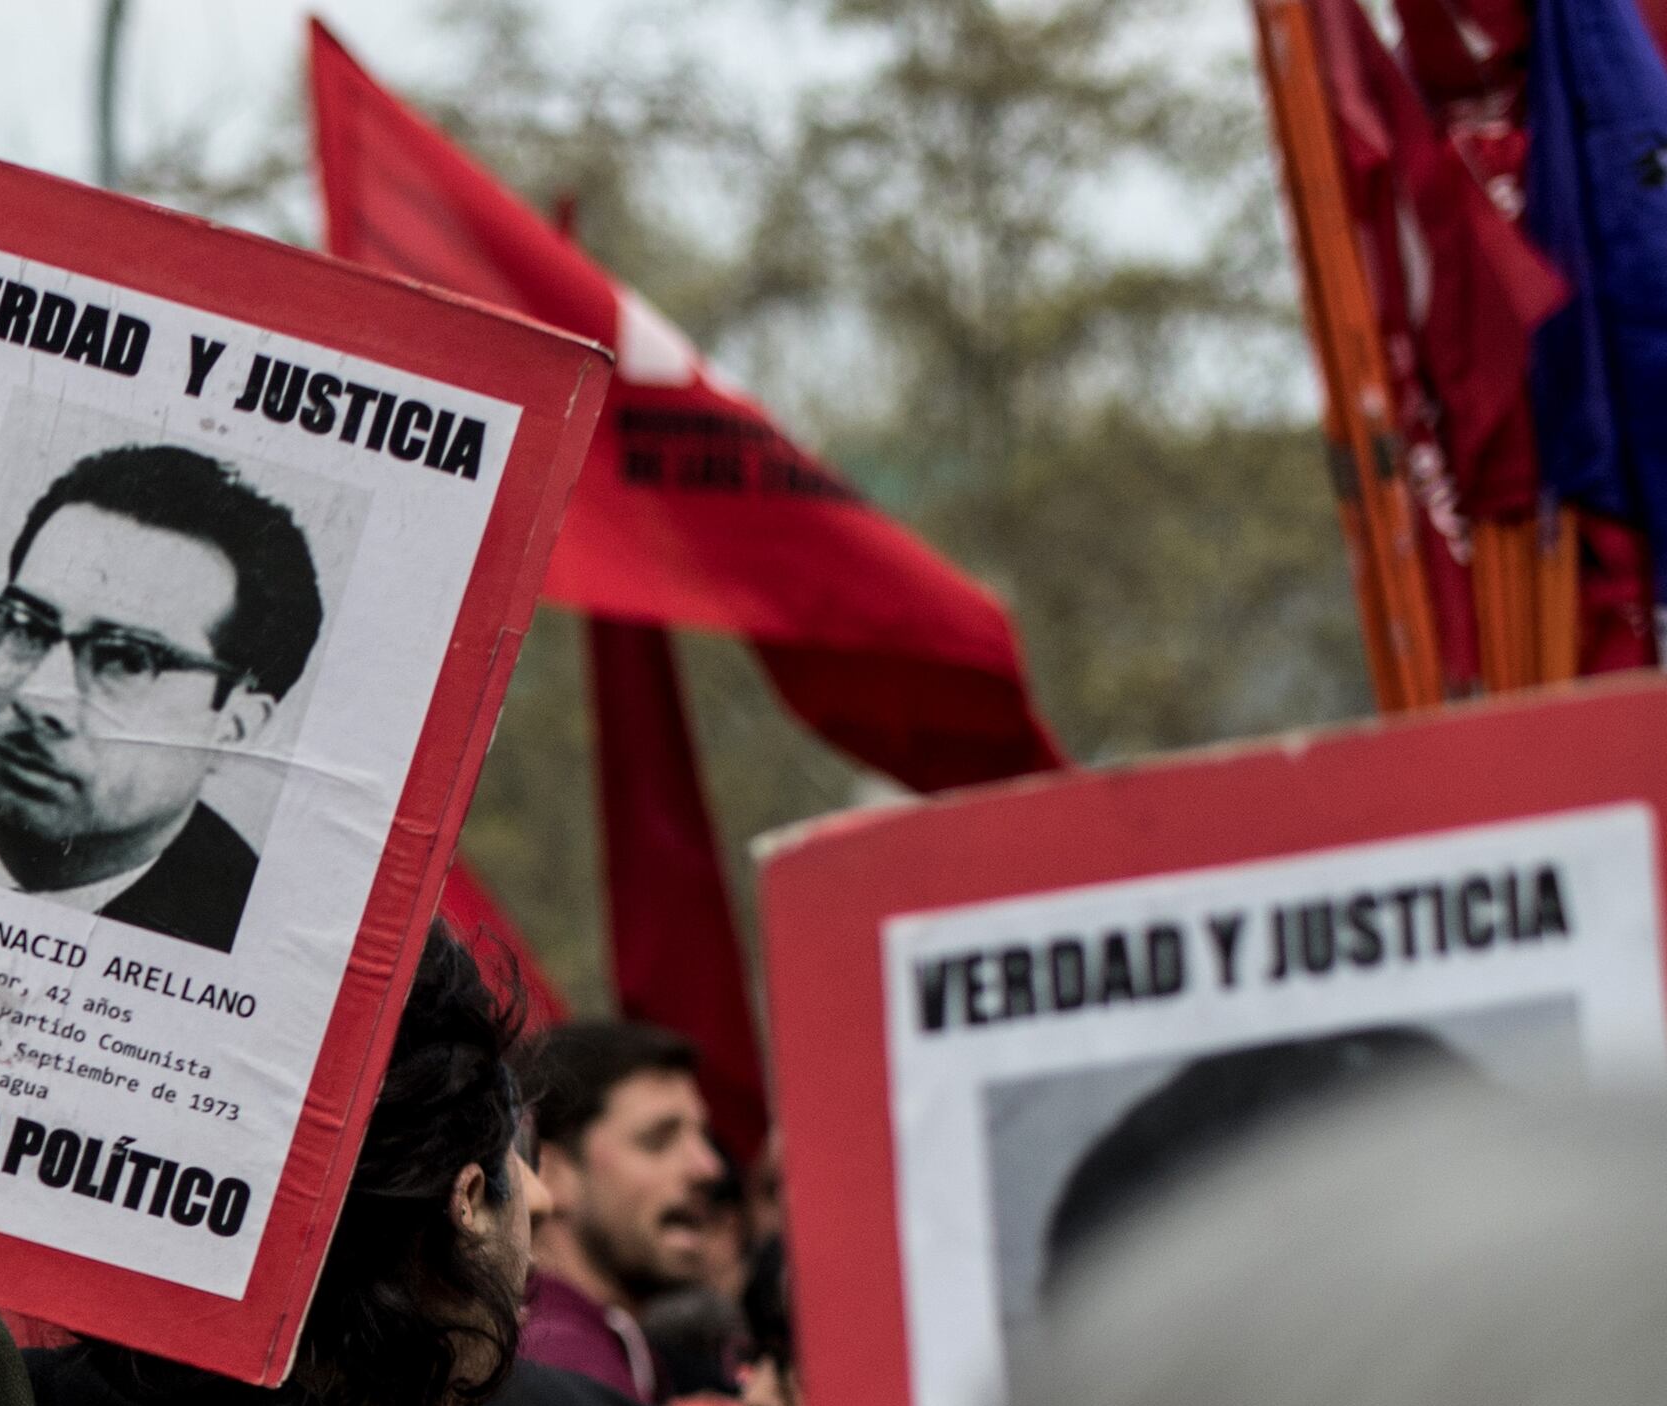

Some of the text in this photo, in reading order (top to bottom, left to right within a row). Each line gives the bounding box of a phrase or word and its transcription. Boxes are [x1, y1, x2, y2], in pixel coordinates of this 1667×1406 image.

[184, 335, 227, 398] Y
[233, 353, 486, 481] JUSTICIA
[102, 956, 256, 1018] ARELLANO
[915, 863, 1573, 1036] VERDAD Y JUSTICIA
[45, 985, 71, 1006] 42
[82, 997, 132, 1023] años
[13, 1042, 140, 1093] Septiembre
[151, 1083, 177, 1104] de
[189, 1093, 240, 1121] 1973
[98, 1033, 212, 1080] Comunista
[1, 1116, 251, 1238] POLÍTICO
